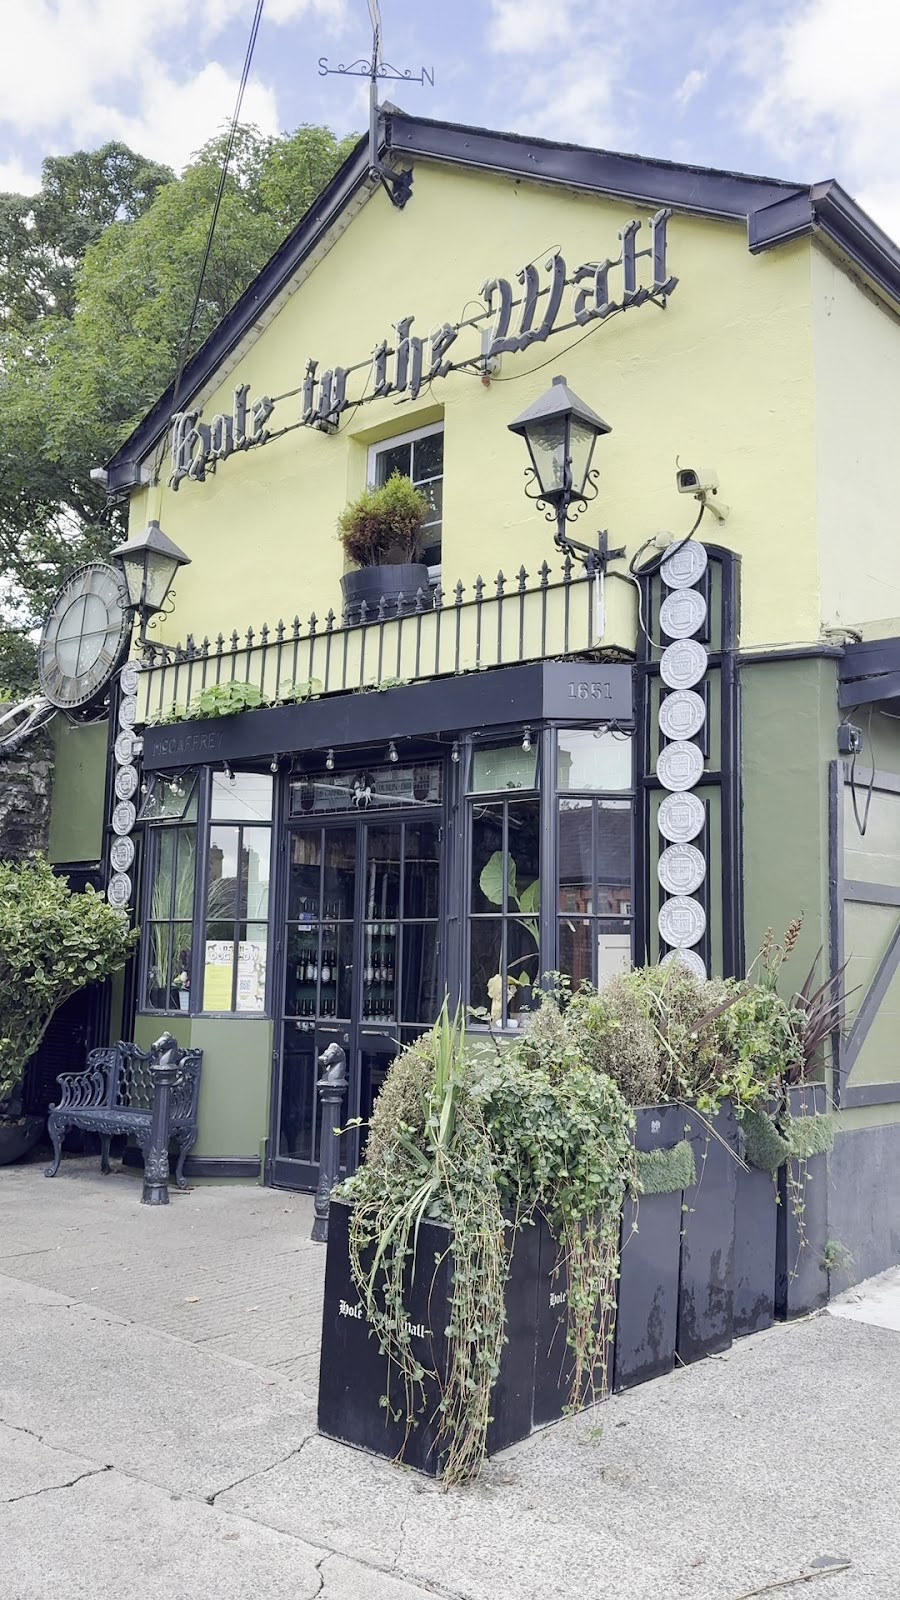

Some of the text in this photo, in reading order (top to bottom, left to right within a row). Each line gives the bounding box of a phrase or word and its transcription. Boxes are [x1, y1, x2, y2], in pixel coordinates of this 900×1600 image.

[318, 57, 328, 76] S
[421, 66, 435, 87] N
[168, 207, 680, 492] Hole in the Wall
[567, 681, 613, 700] 1651
[338, 1299, 363, 1320] Hole
